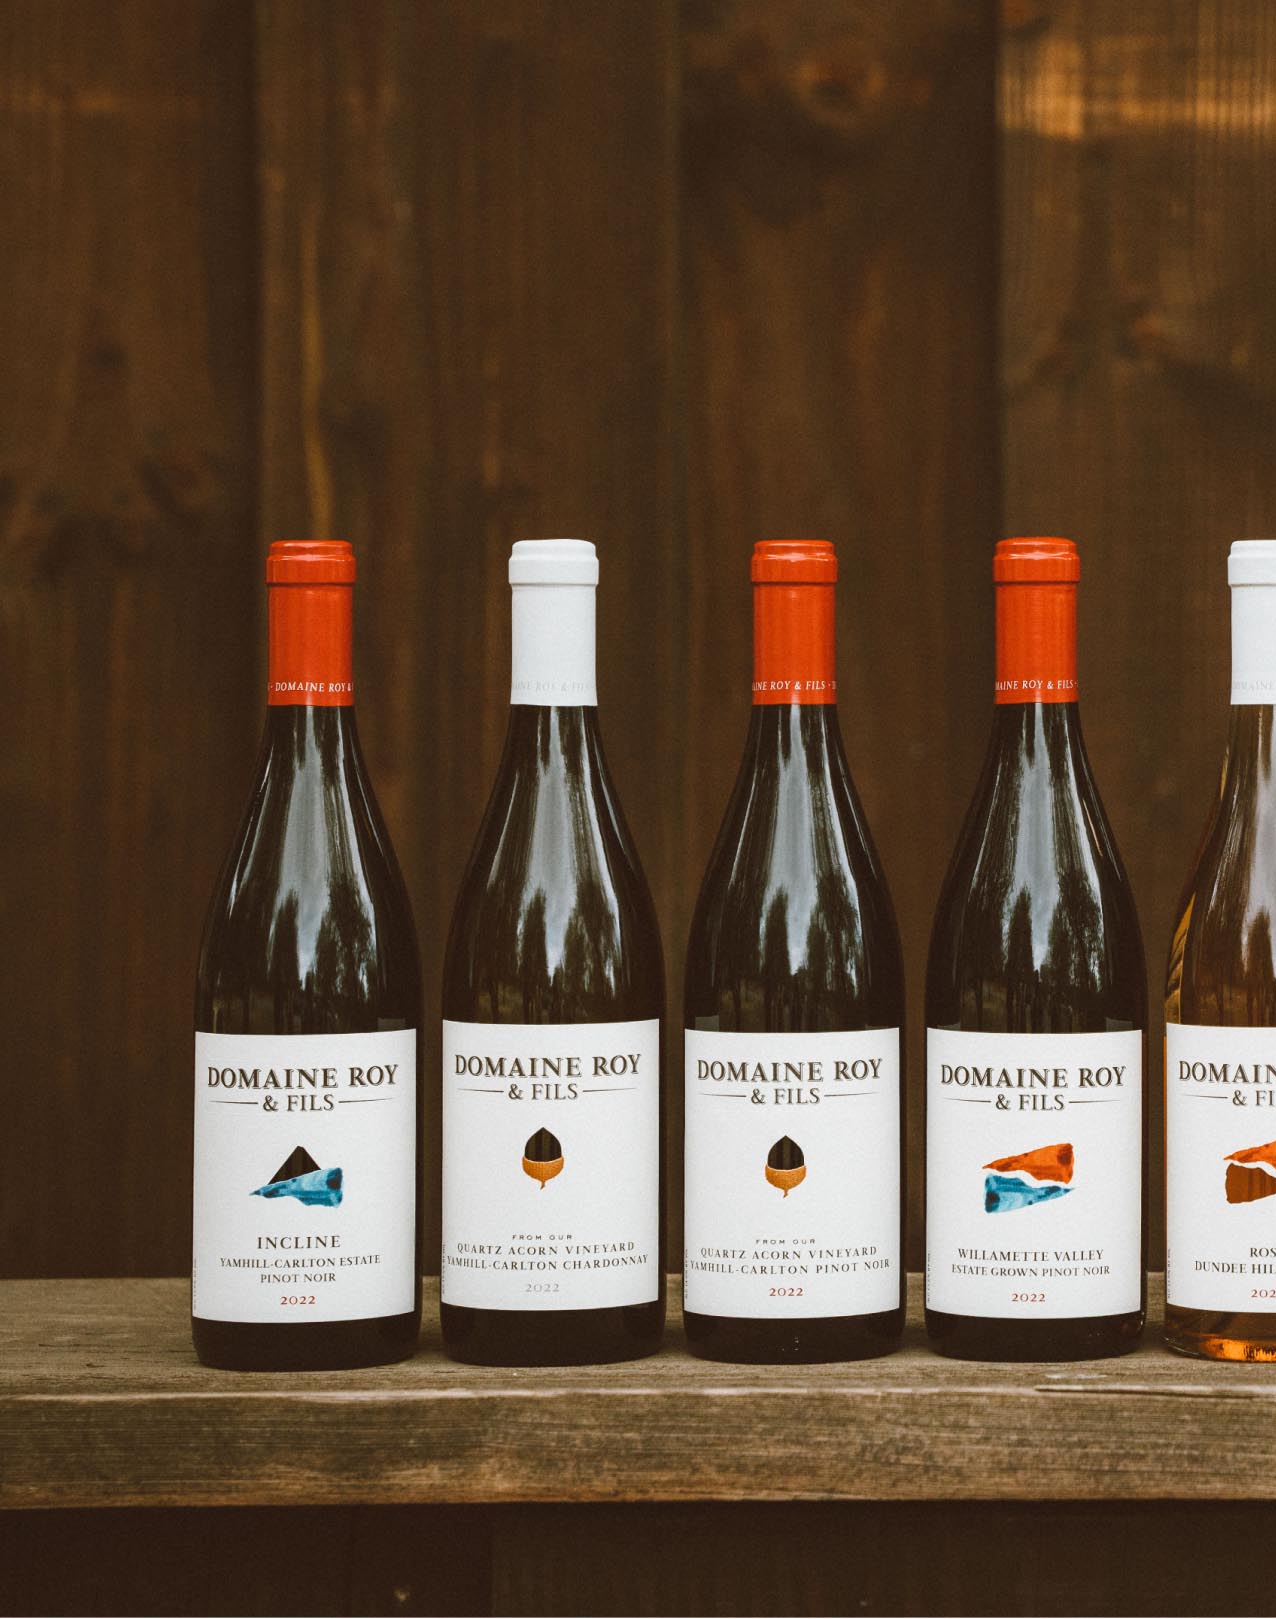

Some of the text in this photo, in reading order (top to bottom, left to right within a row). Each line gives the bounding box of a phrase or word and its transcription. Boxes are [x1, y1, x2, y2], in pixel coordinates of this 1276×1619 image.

[275, 681, 324, 692] DOMAINE
[329, 682, 346, 692] ROY
[770, 681, 791, 690] ROY
[794, 682, 802, 690] &
[806, 680, 825, 690] FILS
[1022, 680, 1043, 689] ROY
[1047, 681, 1054, 689] &
[1057, 680, 1074, 689] FILS
[454, 1054, 642, 1078] DOMAINE ROY
[697, 1058, 883, 1083] DOMAINE ROY
[207, 1064, 399, 1090] DOMAINE ROY
[941, 1064, 1126, 1089] DOMAINE ROY
[508, 1083, 578, 1100] & FILS
[751, 1088, 820, 1105] & FILS
[1232, 1090, 1248, 1106] &
[263, 1094, 334, 1112] & FILS
[995, 1094, 1065, 1111] & FILS
[257, 1235, 340, 1250] INCLINE
[457, 1242, 634, 1256] QUARTZ ACORN VINEYARD
[700, 1246, 877, 1260] QUARTZ ACORN VINEYARD
[958, 1248, 1103, 1261] WILLAMETTE VALLEY
[220, 1255, 380, 1268] YAMHILL-CARLTON ESTATE
[447, 1254, 648, 1271] YAMHILL-CARLTON CHARDONNAY
[690, 1259, 890, 1274] YAMHILL-CARLTON PINOT NOIR
[1195, 1261, 1247, 1273] DUNDEE
[952, 1264, 1110, 1277] ESTATE GROWN PINOT NOIR
[261, 1273, 336, 1283] PINOT NOIR
[526, 1284, 559, 1292] 2022
[769, 1288, 803, 1296] 2022
[280, 1296, 315, 1305] 2022
[1012, 1293, 1045, 1302] 2022
